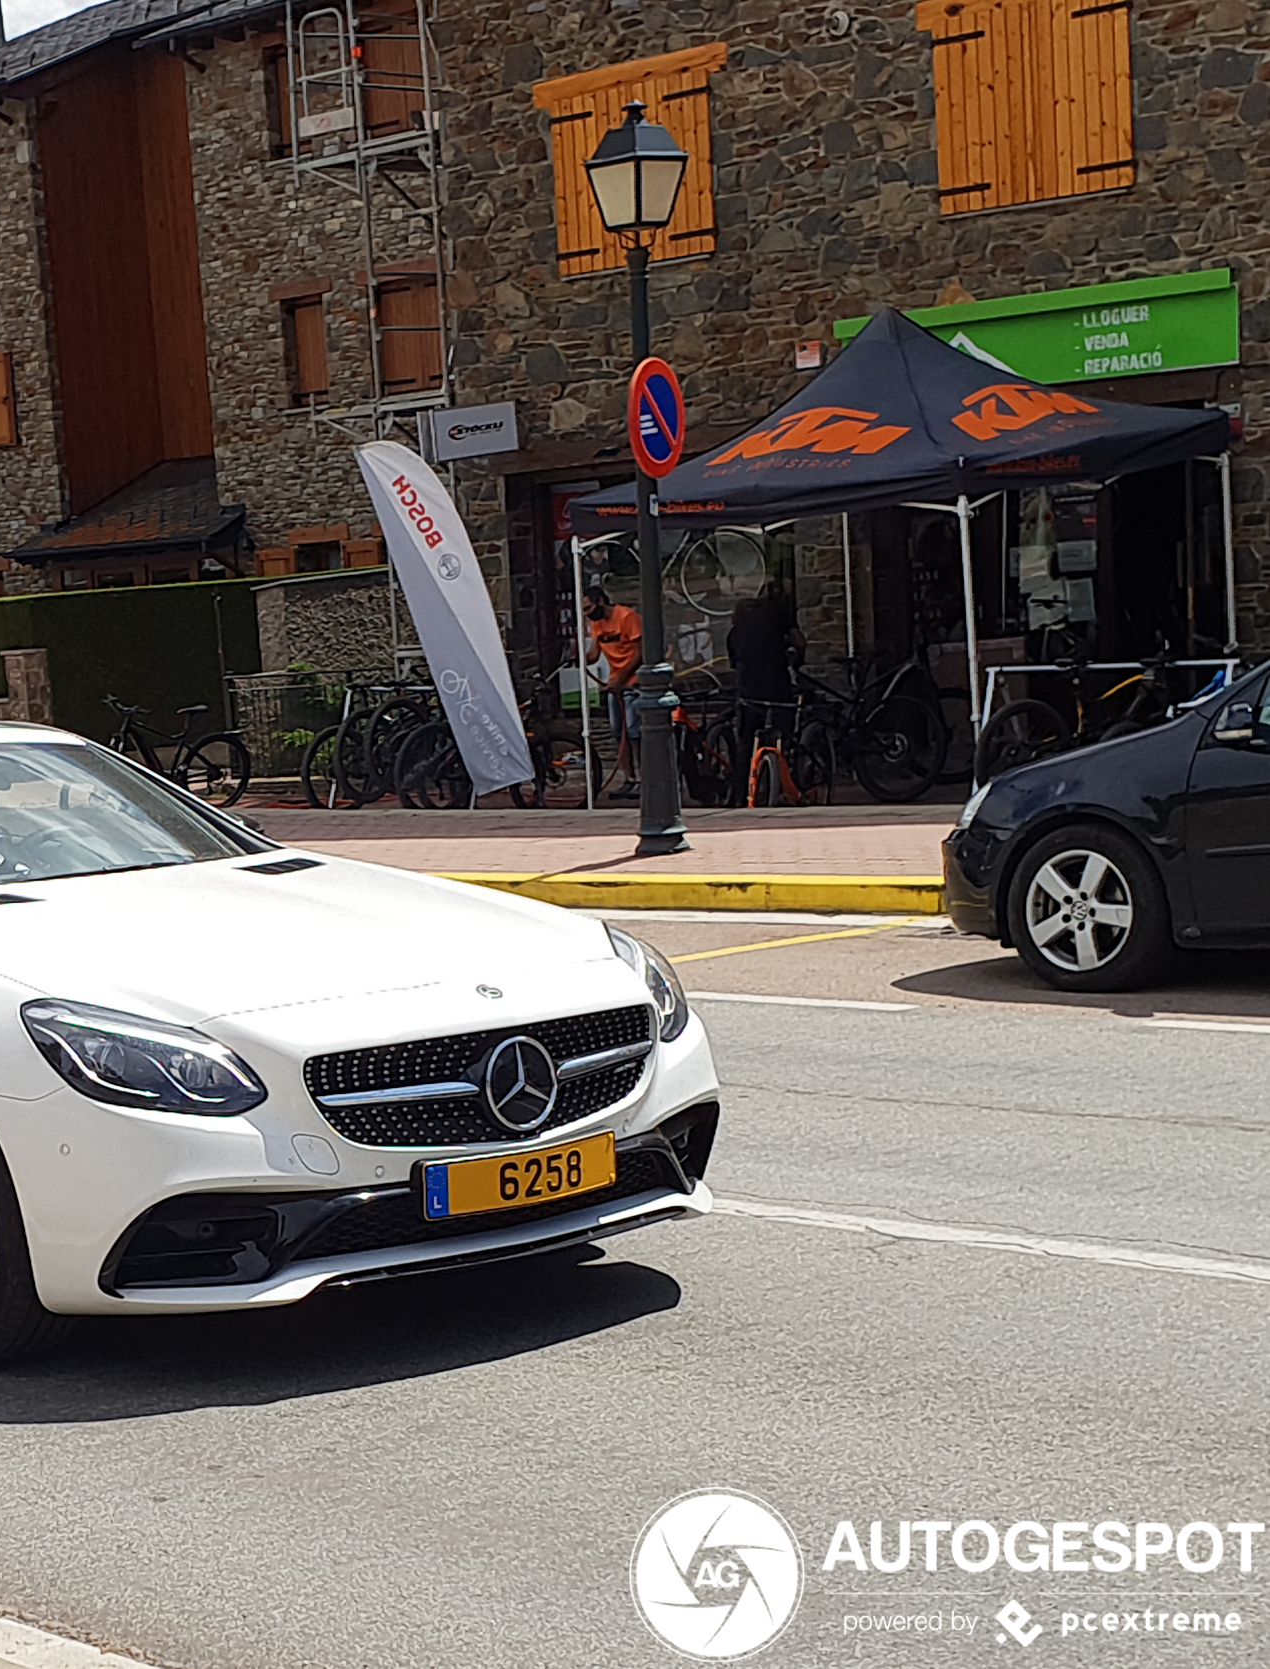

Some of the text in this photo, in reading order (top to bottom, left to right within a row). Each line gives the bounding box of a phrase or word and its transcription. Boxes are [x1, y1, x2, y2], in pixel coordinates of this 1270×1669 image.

[1083, 305, 1150, 328] LLOGUER
[1084, 332, 1129, 351] VENDA
[1084, 344, 1163, 375] REPARACIÓ
[950, 384, 1102, 441] KTM
[705, 407, 912, 466] KTM
[433, 1150, 581, 1209] L 6258
